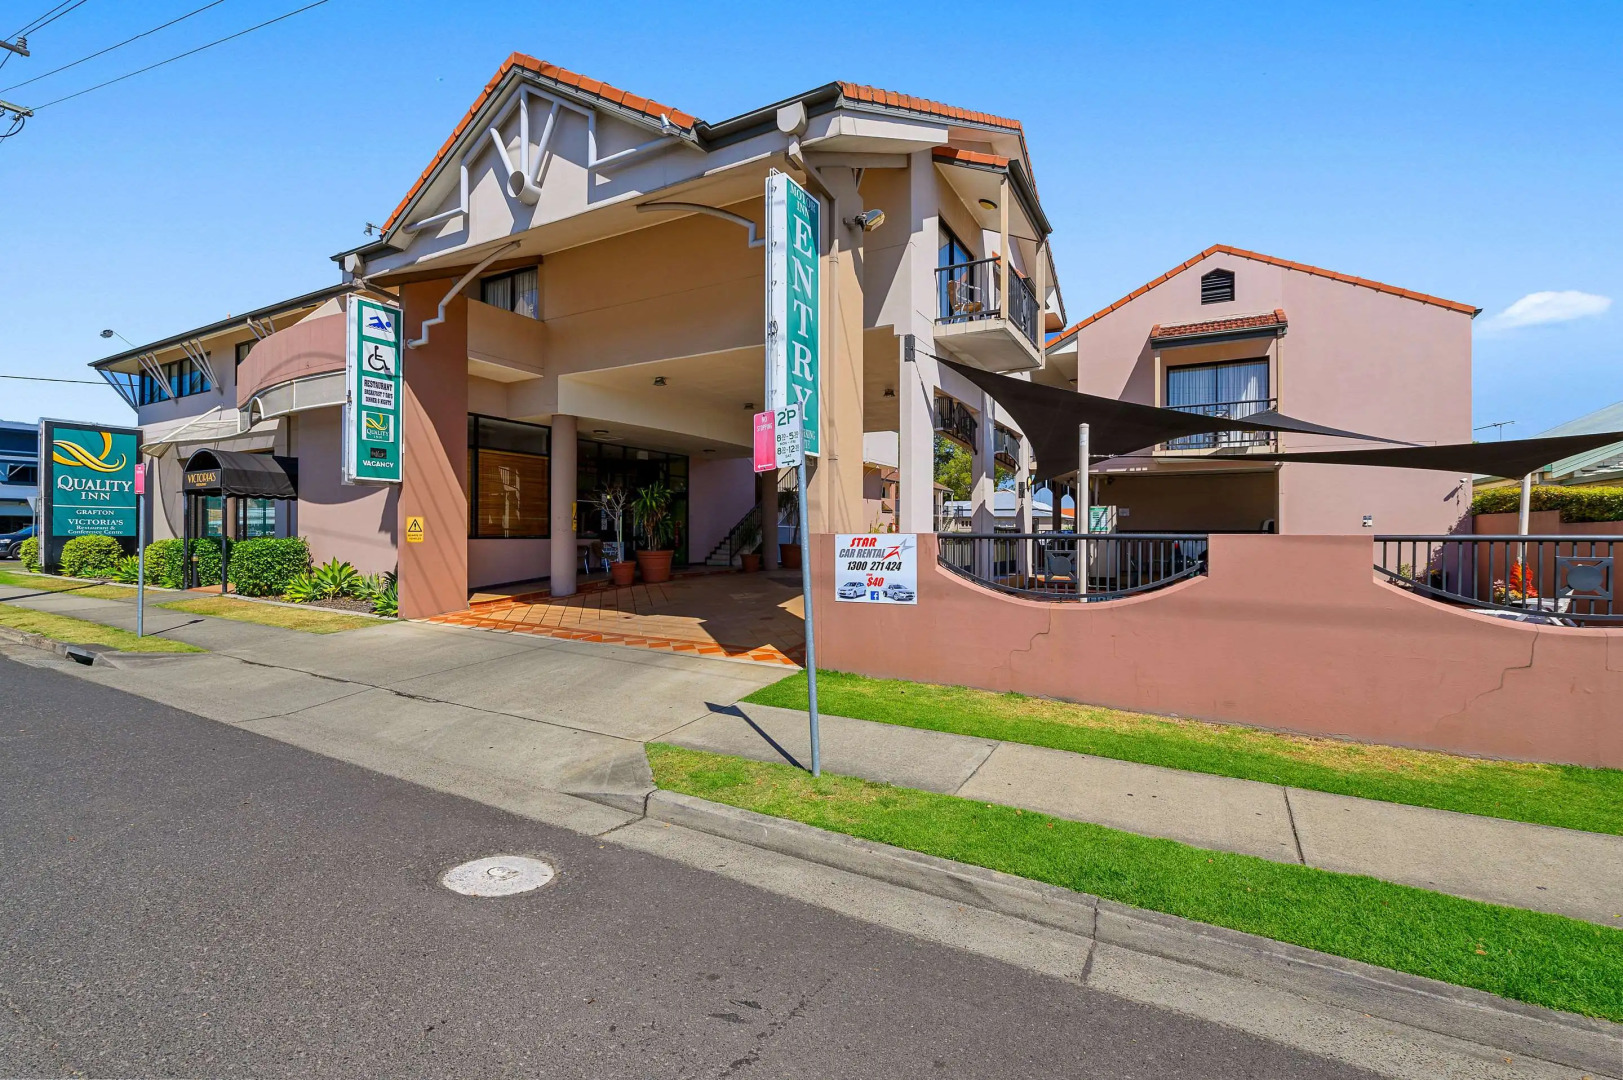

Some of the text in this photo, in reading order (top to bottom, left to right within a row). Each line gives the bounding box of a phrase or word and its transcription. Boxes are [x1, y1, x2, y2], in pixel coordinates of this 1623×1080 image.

[789, 183, 816, 213] MOTOR
[796, 200, 810, 219] INN
[791, 215, 814, 420] ENTRY
[364, 379, 393, 392] RESTAURANT
[777, 409, 797, 426] 2P
[366, 428, 389, 437] QUALITY
[362, 459, 395, 468] VACANCY
[57, 474, 133, 492] QUALITY
[81, 491, 111, 501] INN
[67, 518, 124, 526] VICTORIA'S
[850, 536, 878, 547] STAR
[839, 548, 886, 558] CAR RENTAL
[847, 561, 903, 571] 1300 271 424
[866, 576, 885, 587] $40
